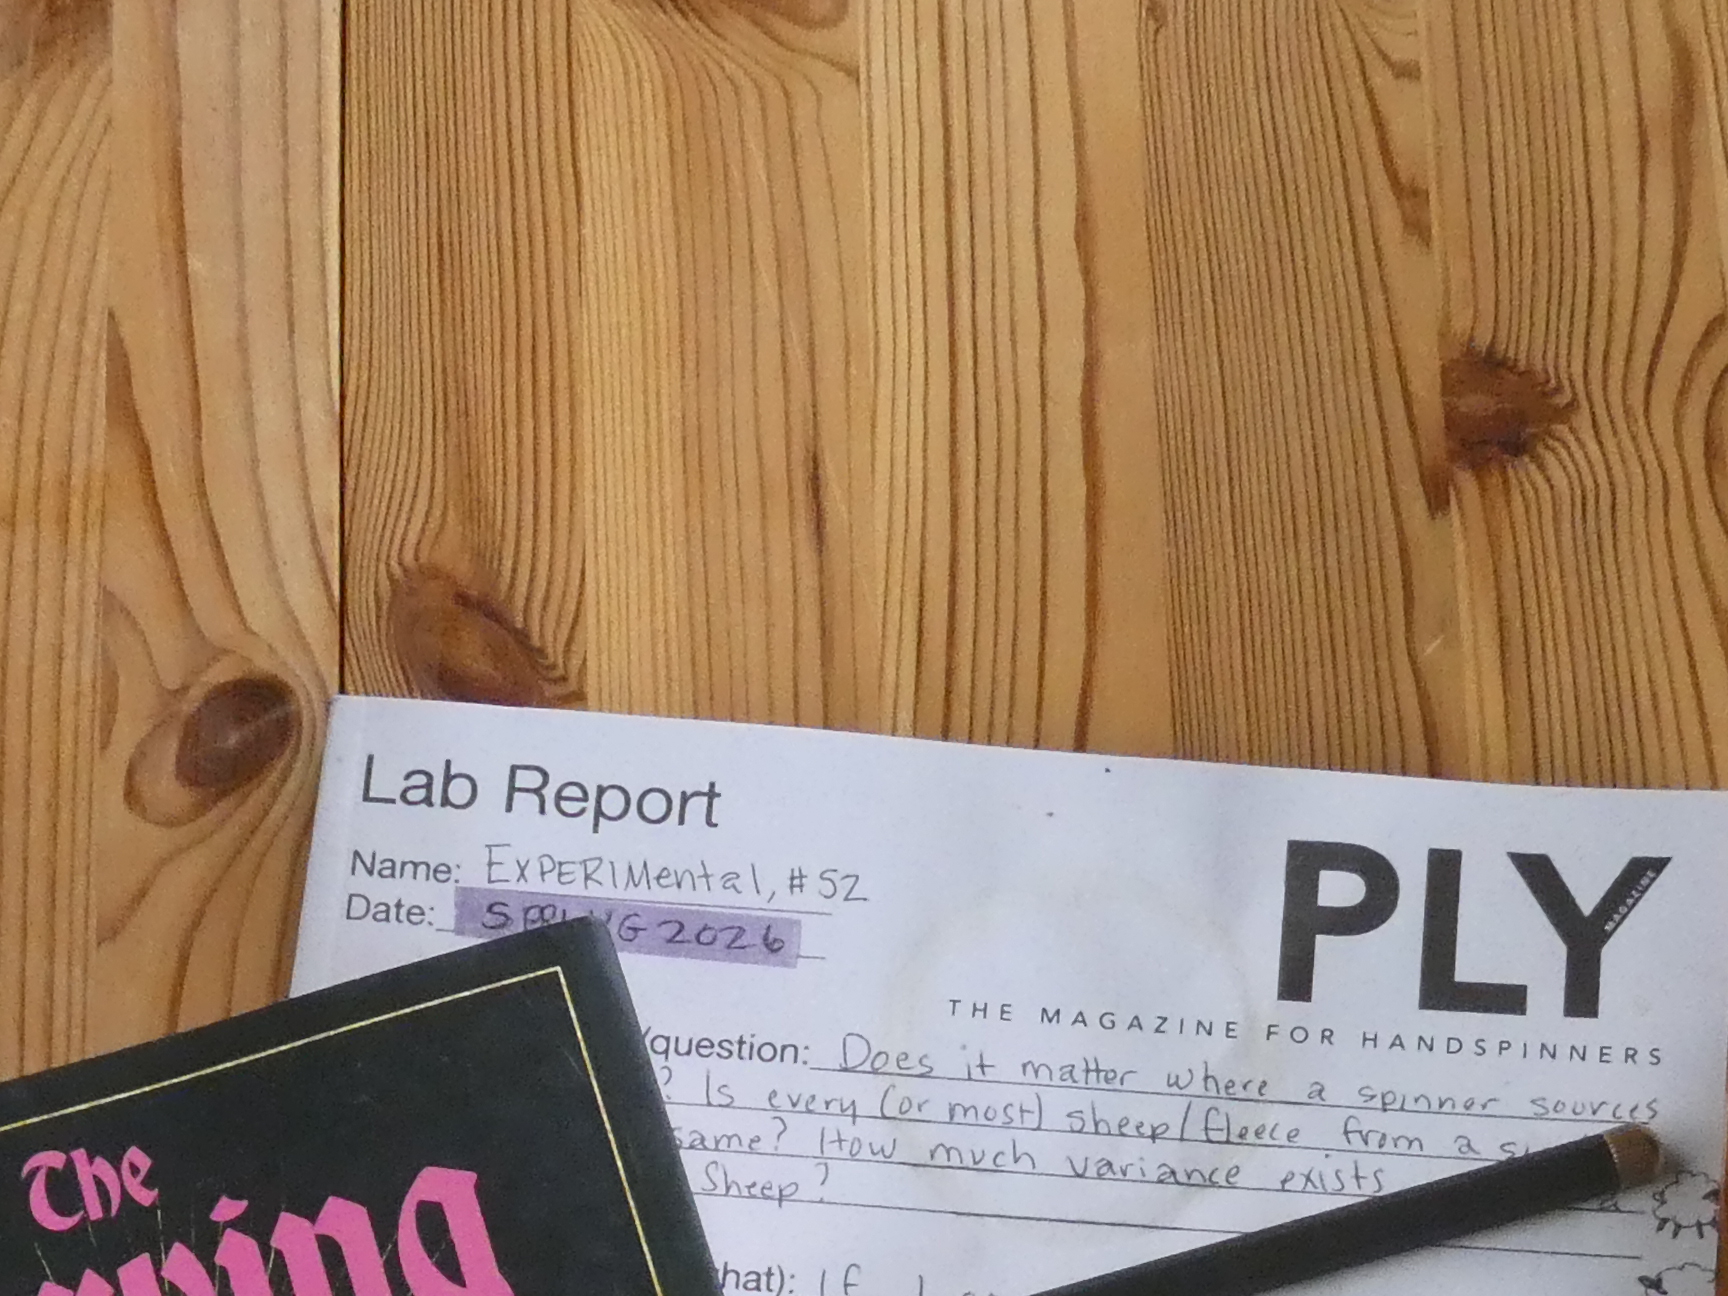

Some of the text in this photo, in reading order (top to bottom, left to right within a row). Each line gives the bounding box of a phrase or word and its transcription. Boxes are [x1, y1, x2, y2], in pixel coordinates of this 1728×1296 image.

[361, 754, 721, 833] Lab Report
[351, 849, 463, 885] Name:
[345, 893, 435, 927] Date:
[659, 919, 785, 954] 2026
[1276, 839, 1674, 1019] PLY
[950, 1000, 1664, 1067] THE MAGAZINE FOR HANDSPINNERS
[704, 1072, 735, 1108] Is
[768, 1087, 859, 1126] every
[880, 1089, 936, 1121] (or
[948, 1095, 1043, 1130] most)
[1065, 1100, 1303, 1150] sheep/fleece
[1340, 1123, 1425, 1156] from
[1454, 1135, 1482, 1159] a
[842, 1033, 933, 1075] Does
[964, 1044, 996, 1080] it
[1021, 1056, 1138, 1087] matter
[1165, 1062, 1269, 1100] where
[1307, 1079, 1327, 1102] a
[1357, 1084, 1498, 1118] spinner
[1529, 1097, 1660, 1123] sources
[21, 1144, 160, 1232] The
[819, 1130, 898, 1161] How
[928, 1138, 1038, 1171] much
[1072, 1152, 1242, 1187] variance
[1279, 1162, 1387, 1196] exists
